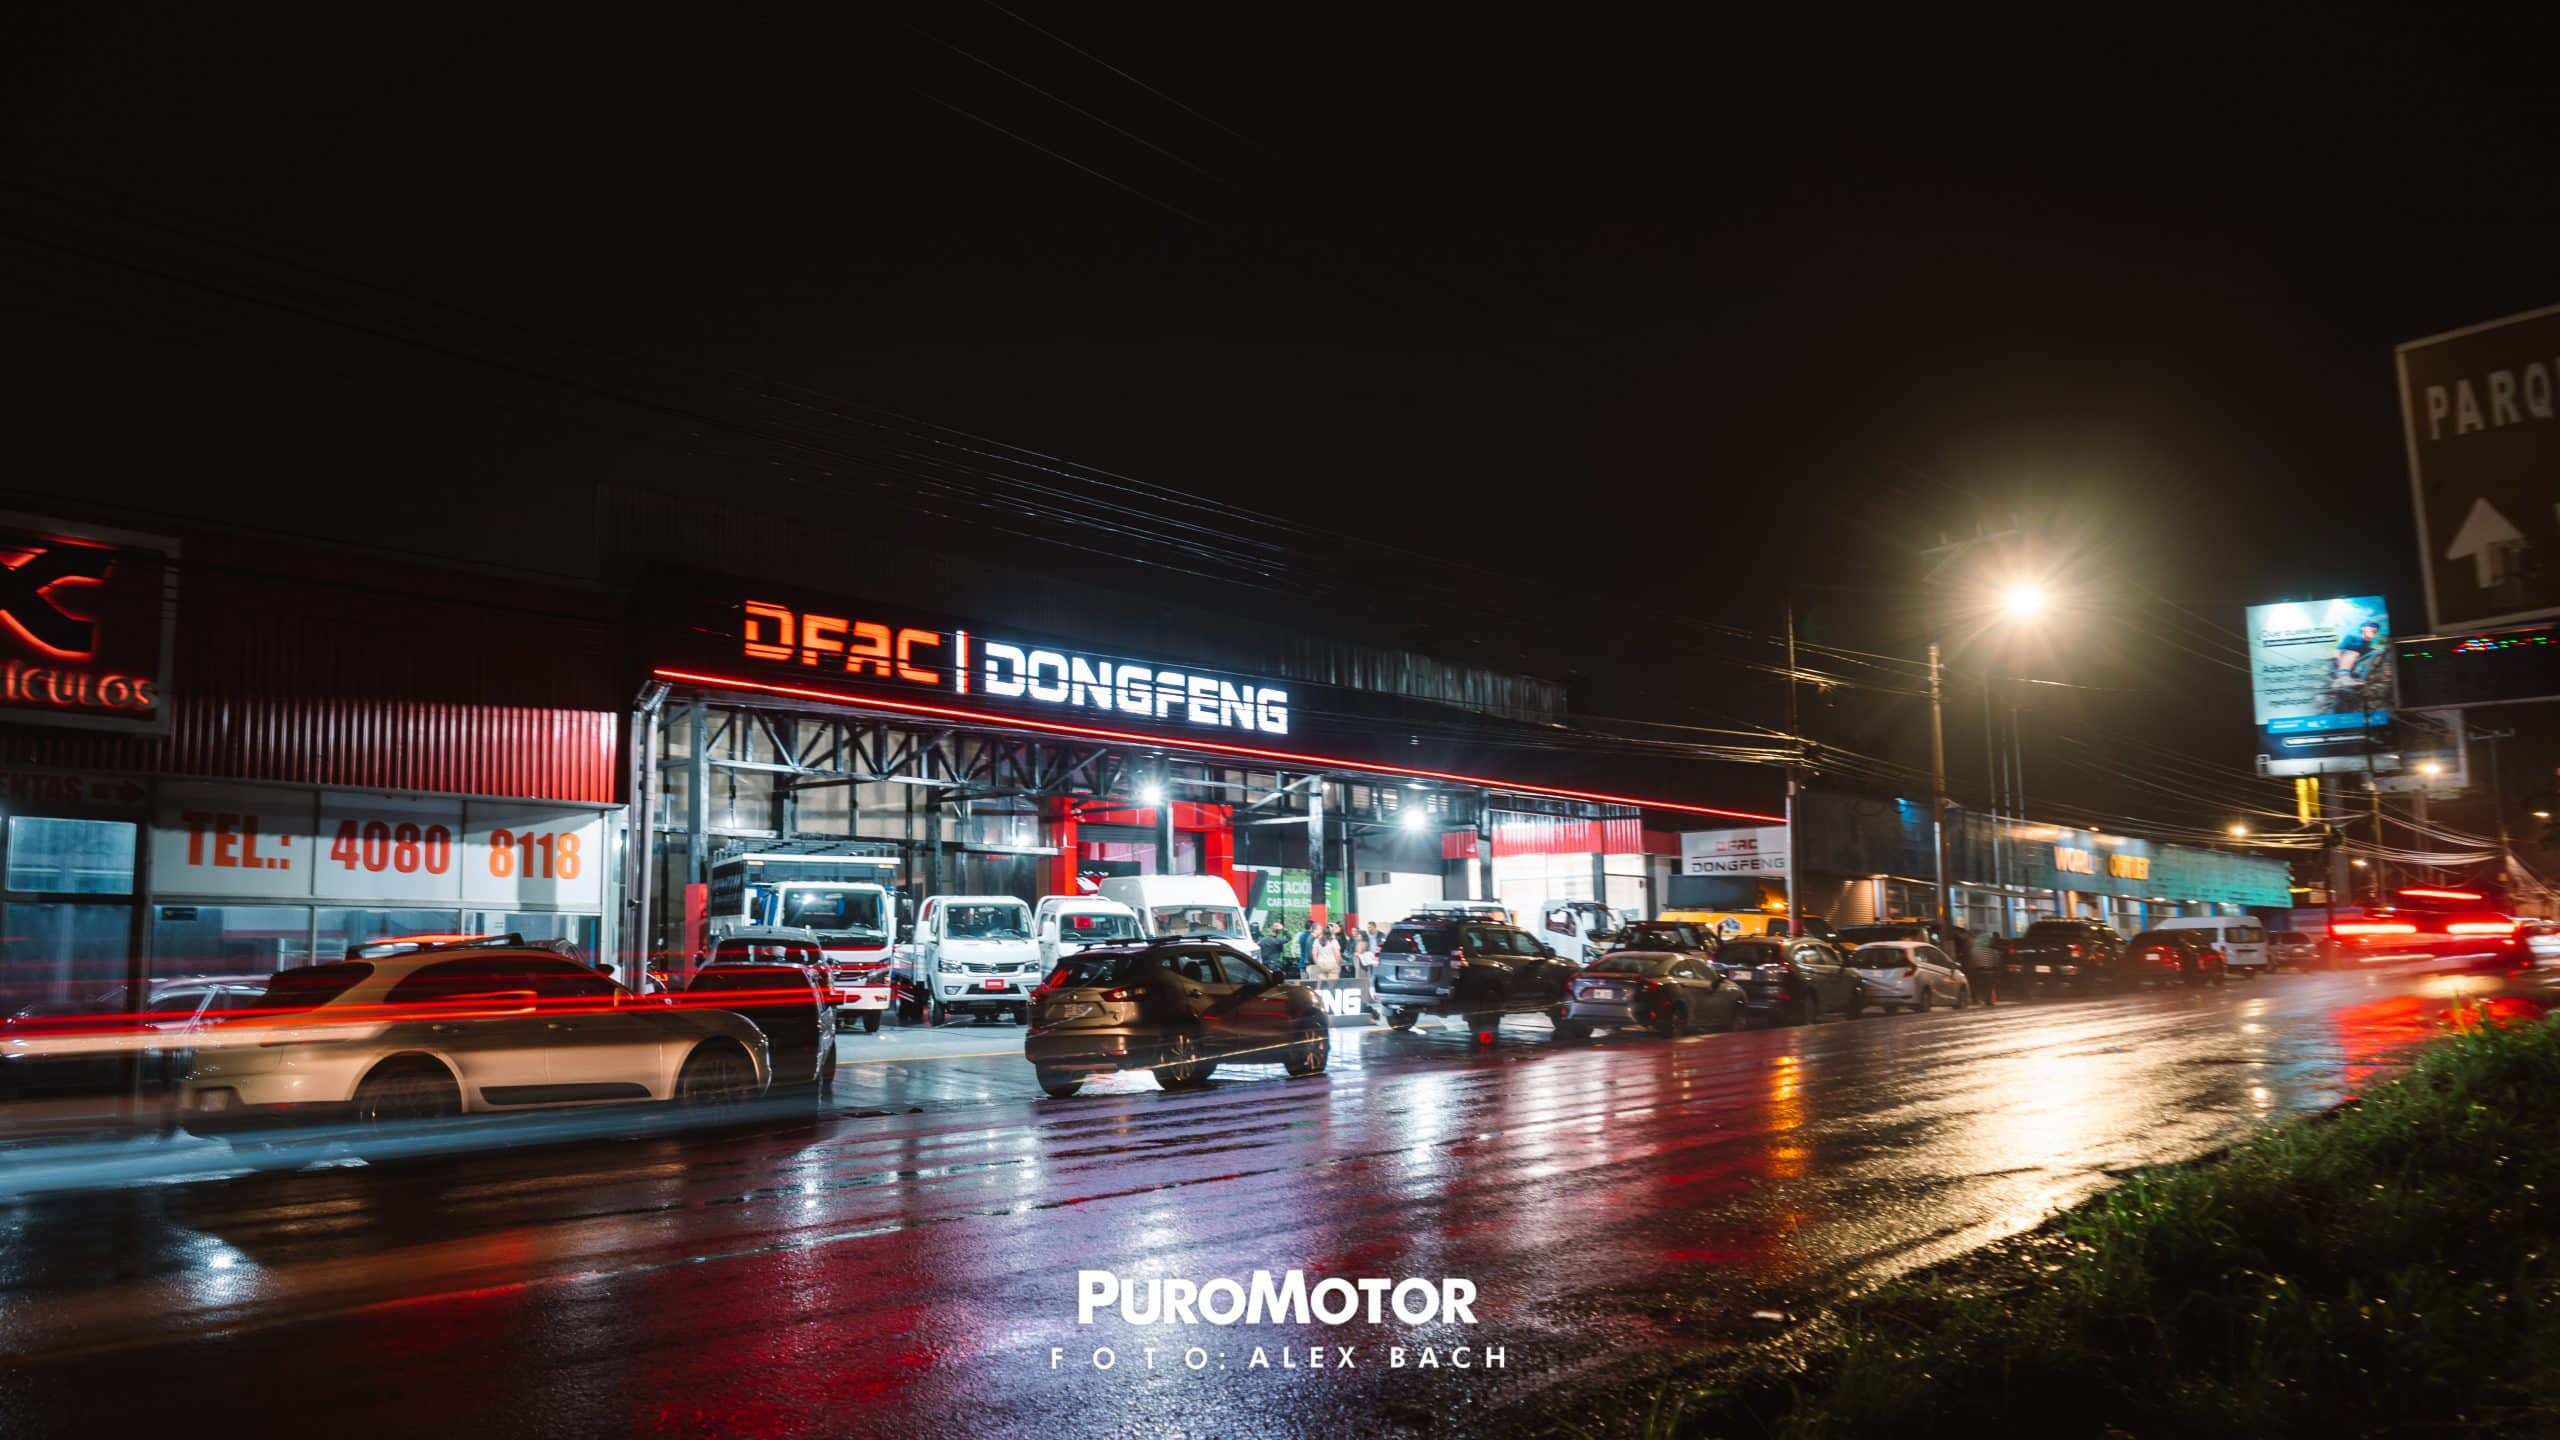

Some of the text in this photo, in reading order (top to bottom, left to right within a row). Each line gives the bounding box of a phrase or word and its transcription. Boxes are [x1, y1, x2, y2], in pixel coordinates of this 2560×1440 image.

[2425, 355, 2560, 440] PARQ
[743, 600, 1290, 735] DFAC DONGFENG
[181, 811, 581, 880] TEL.: 4080 8118
[1692, 857, 1785, 873] DONGFENG
